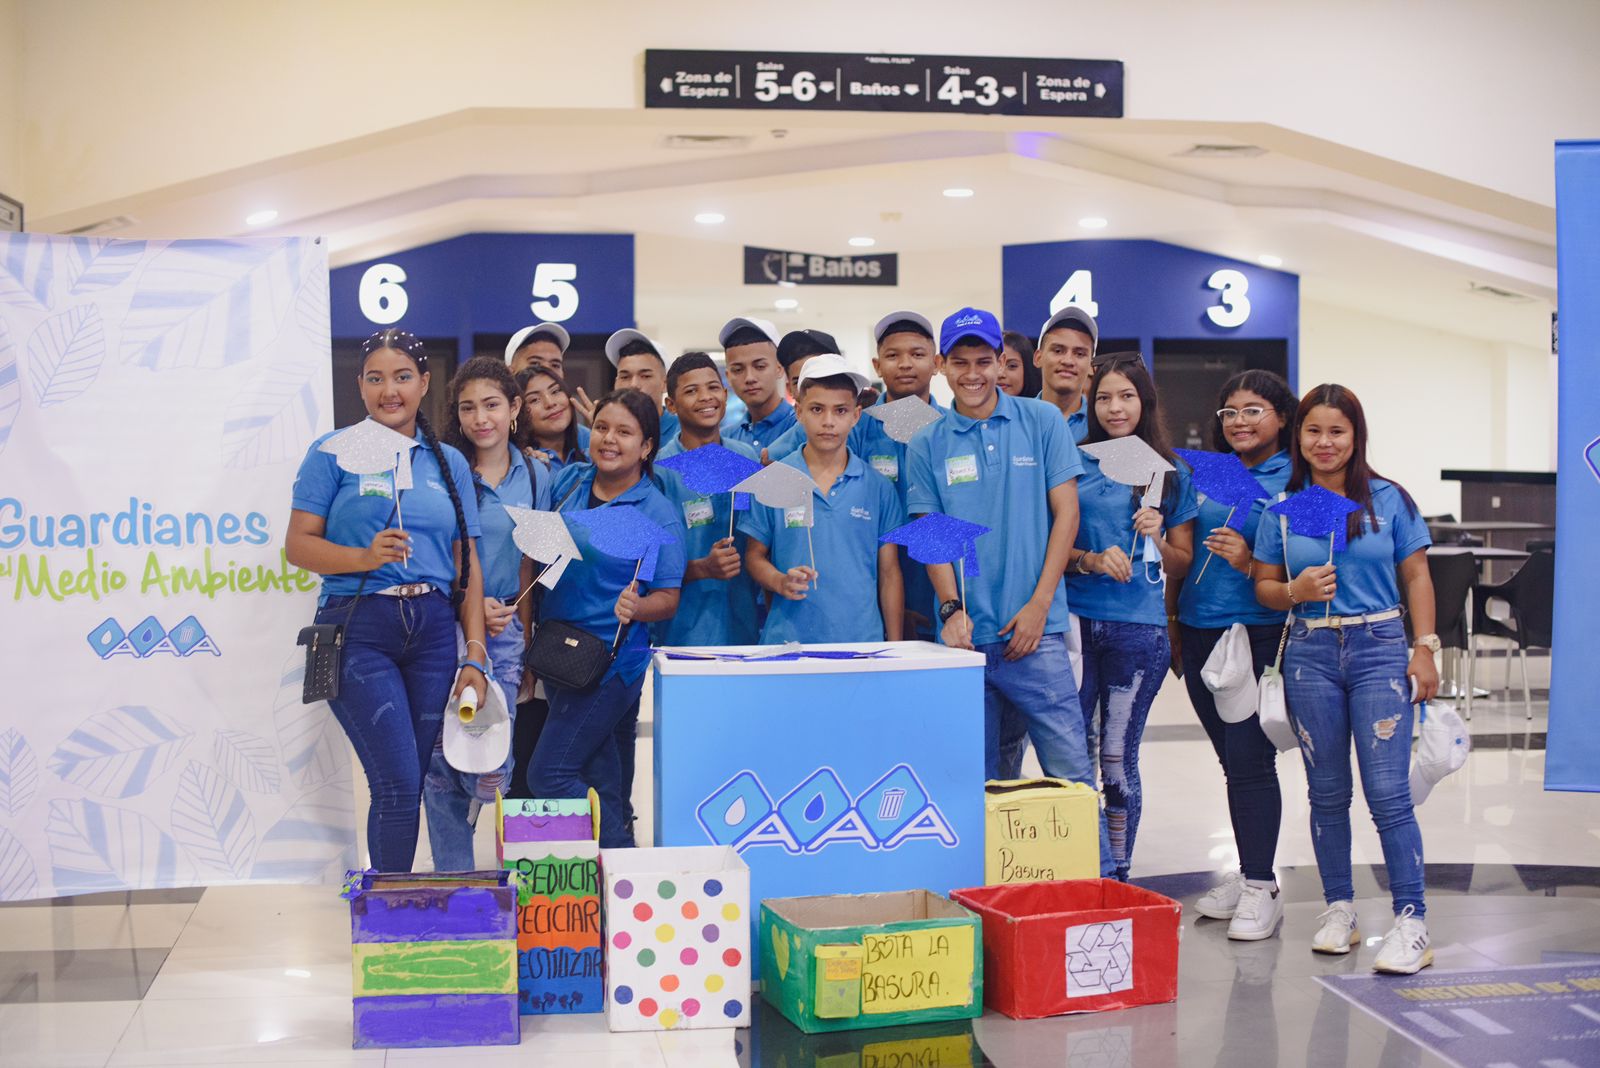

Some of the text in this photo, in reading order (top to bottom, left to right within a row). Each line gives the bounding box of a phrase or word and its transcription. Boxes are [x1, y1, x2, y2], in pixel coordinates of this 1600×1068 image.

[675, 72, 732, 83] Zona de
[757, 62, 784, 71] Salas
[943, 66, 971, 76] Salas
[1036, 75, 1091, 88] Zona de
[679, 85, 729, 99] Espera
[754, 71, 817, 102] 5-6
[850, 81, 900, 96] Baños
[937, 75, 999, 106] 4-3
[1040, 89, 1087, 103] Espera
[808, 255, 881, 277] Baños
[359, 263, 408, 324] 6
[530, 263, 579, 322] 5
[1050, 270, 1098, 317] 4
[1207, 269, 1251, 327] 3
[0, 496, 269, 549] Guardianes
[14, 548, 127, 602] Medio
[141, 547, 317, 599] Ambiente
[999, 806, 1069, 840] Tira tu
[998, 847, 1054, 883] Basura
[865, 934, 949, 964] BOTA LA
